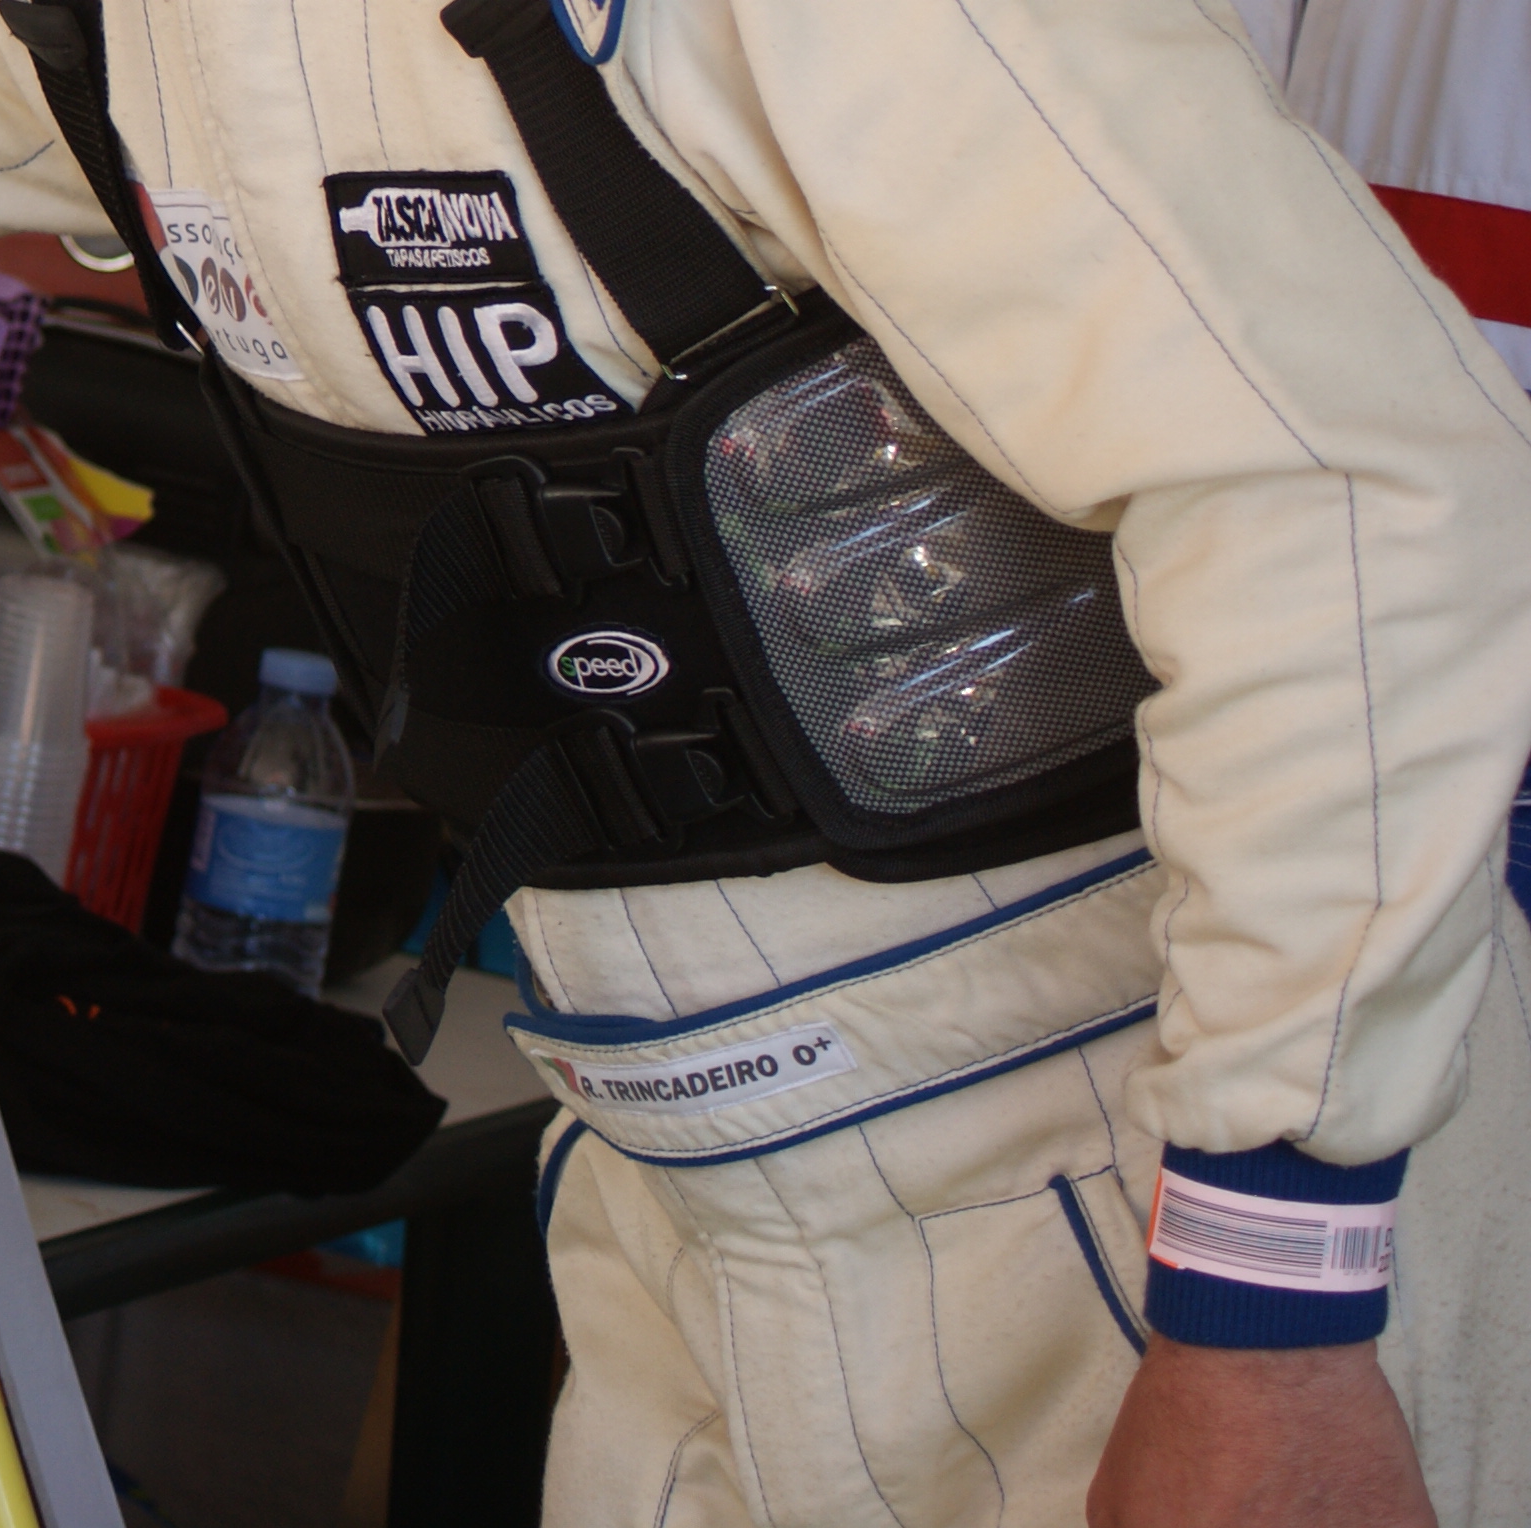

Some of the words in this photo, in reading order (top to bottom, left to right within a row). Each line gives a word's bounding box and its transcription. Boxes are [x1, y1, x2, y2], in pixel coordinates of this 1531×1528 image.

[367, 302, 558, 408] HIP
[560, 648, 642, 689] speed
[580, 1076, 604, 1100] R.
[606, 1054, 779, 1103] TRINCADEIRO
